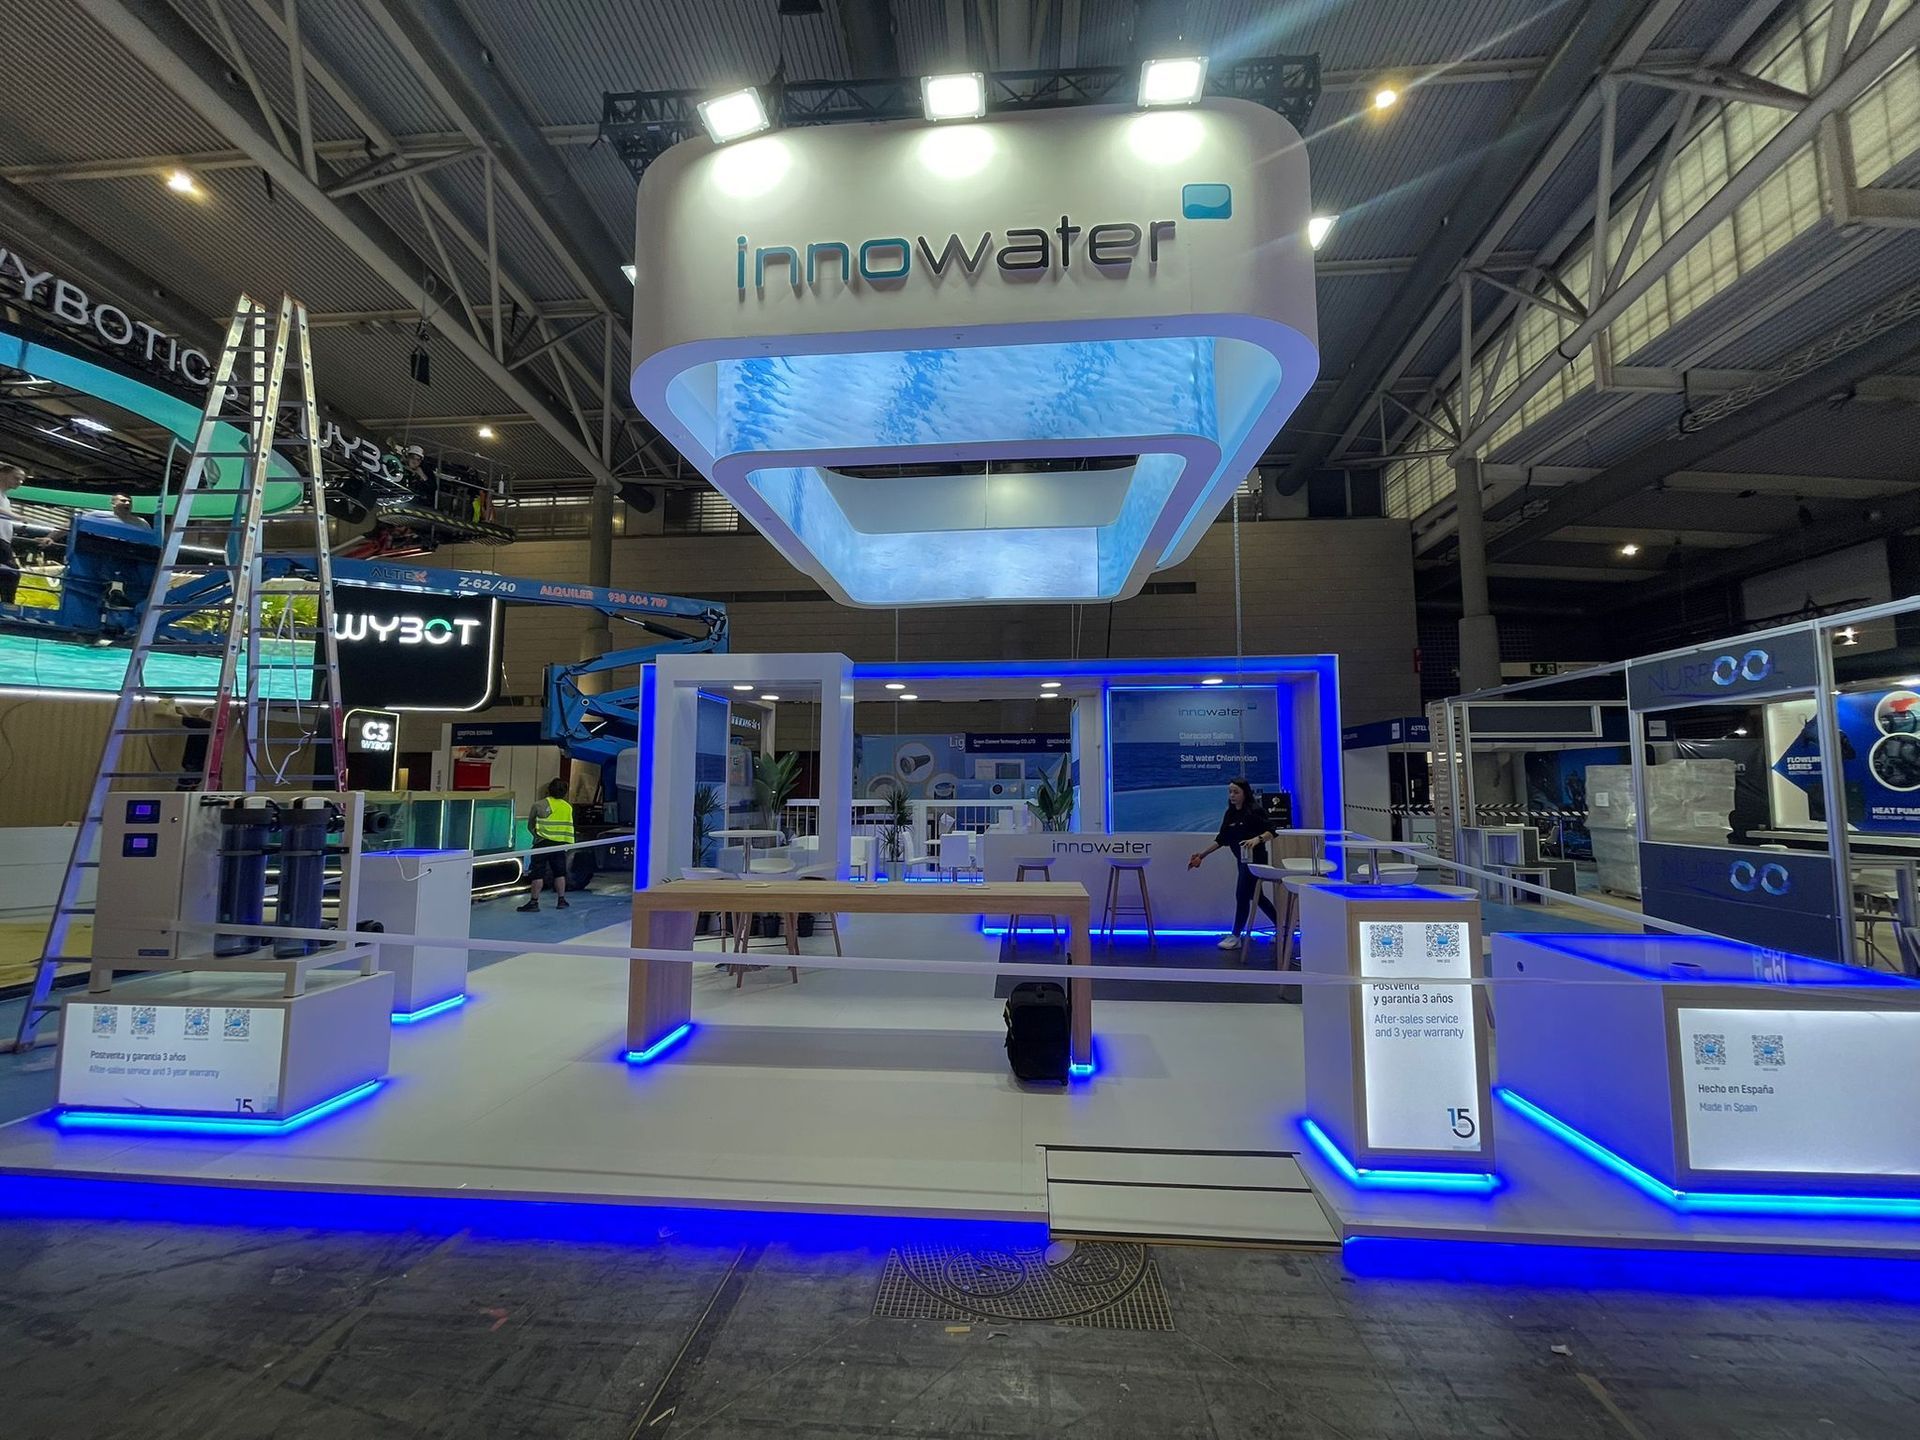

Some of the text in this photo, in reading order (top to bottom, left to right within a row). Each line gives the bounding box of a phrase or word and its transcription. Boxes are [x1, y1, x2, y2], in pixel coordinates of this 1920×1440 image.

[735, 214, 1177, 290] innowater
[370, 567, 428, 583] ALTEX
[458, 577, 516, 592] Z-62/40
[540, 584, 593, 600] ALQUILER
[608, 592, 626, 604] 938
[629, 594, 648, 606] 404
[332, 612, 481, 646] WYBOT
[1178, 708, 1244, 717] innowater
[362, 721, 390, 741] C3
[1872, 806, 1895, 814] HEAT
[1052, 839, 1152, 854] innowater
[1372, 983, 1420, 991] Postventa
[1373, 993, 1454, 1006] y garantía 3 años
[1374, 1013, 1459, 1024] After-sales service
[1375, 1027, 1465, 1040] and 3 year warranty
[90, 1050, 125, 1060] Postventa
[126, 1053, 131, 1062] y
[163, 1052, 168, 1061] 3
[169, 1052, 186, 1061] años
[152, 1068, 166, 1076] and
[166, 1068, 172, 1077] 3
[1698, 1083, 1775, 1096] Hecho en España
[235, 1098, 254, 1113] 15
[1699, 1102, 1758, 1114] Made in Spain
[1447, 1108, 1475, 1138] 15
